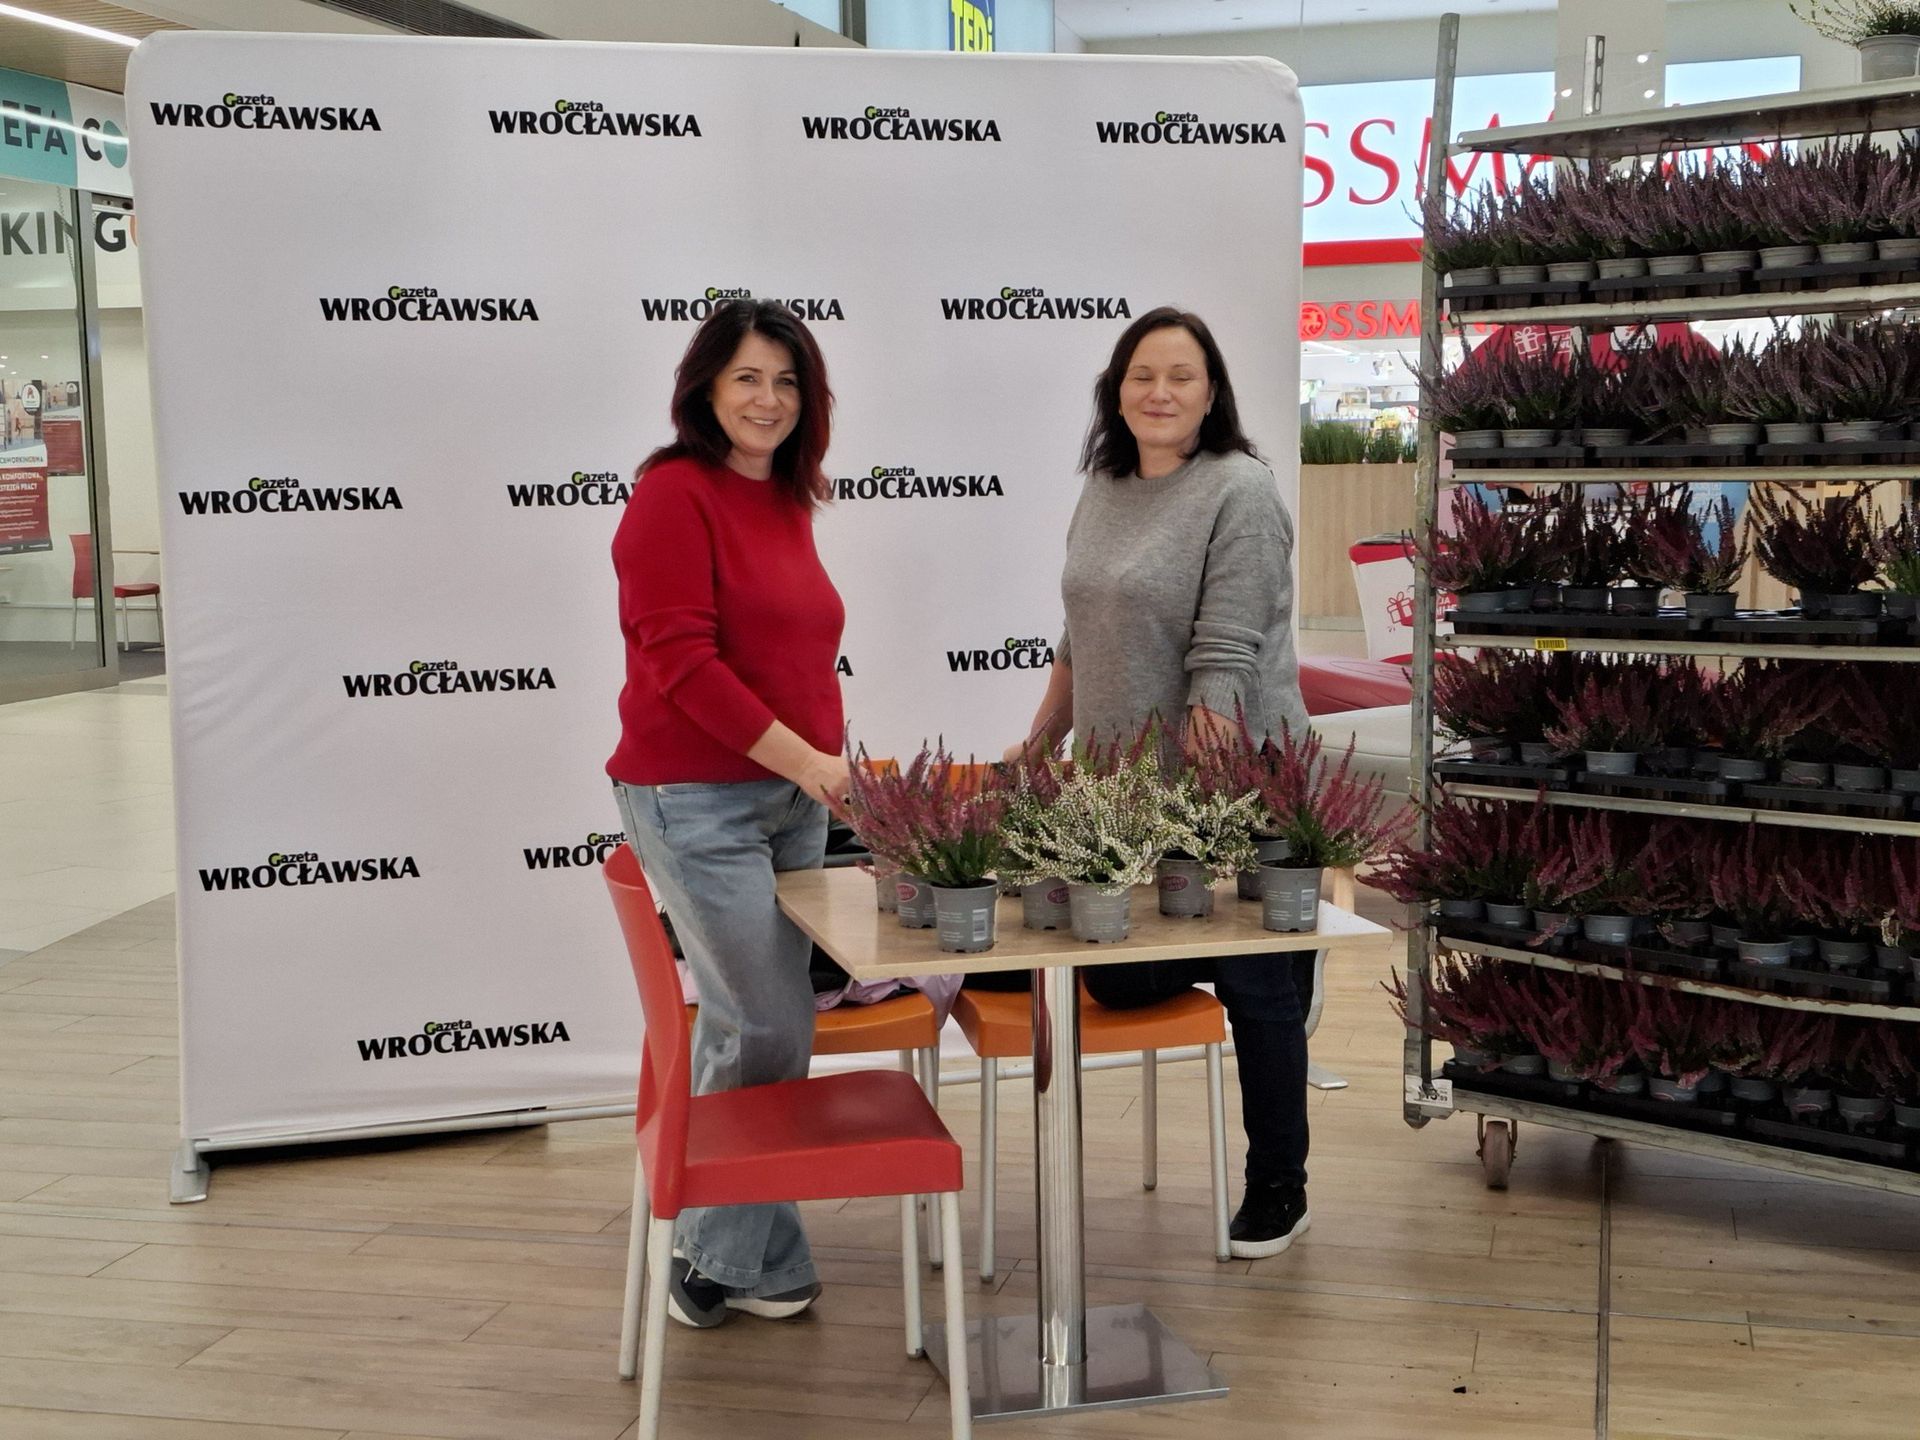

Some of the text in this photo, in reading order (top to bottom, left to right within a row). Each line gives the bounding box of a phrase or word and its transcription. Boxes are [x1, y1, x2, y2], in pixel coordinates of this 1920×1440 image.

[951, 0, 993, 53] TEDi
[223, 93, 275, 107] Gazeta
[555, 99, 604, 114] Gazeta
[150, 102, 382, 131] WROCŁAWSKA
[864, 105, 910, 120] Gazeta
[1155, 111, 1199, 125] Gazeta
[488, 110, 702, 137] WROCŁAWSKA
[802, 116, 1002, 142] WROCŁAWSKA
[1096, 122, 1286, 144] WROCŁAWSKA
[1, 210, 139, 256] KING
[388, 286, 438, 300] Gazeta
[704, 287, 751, 301] Gazeta
[1000, 286, 1044, 300] Gazeta
[319, 298, 539, 321] WROCŁAWSKA
[940, 297, 1132, 321] WROCŁAWSKA
[571, 471, 619, 485] Gazeta
[871, 465, 915, 479] Gazeta
[248, 477, 299, 492] Gazeta
[178, 486, 403, 515] WROCŁAWSKA
[507, 482, 638, 507] WROCŁA
[1004, 636, 1047, 651] Gazeta
[409, 659, 458, 675] Gazeta
[342, 667, 557, 698] WROCŁAWSKA
[586, 831, 627, 846] Gazet
[268, 851, 319, 867] Gazeta
[523, 843, 624, 870] WROC
[198, 856, 420, 891] WROCŁAWSKA
[424, 1019, 473, 1036] Gazeta
[357, 1020, 571, 1061] WROCŁAWSKA
